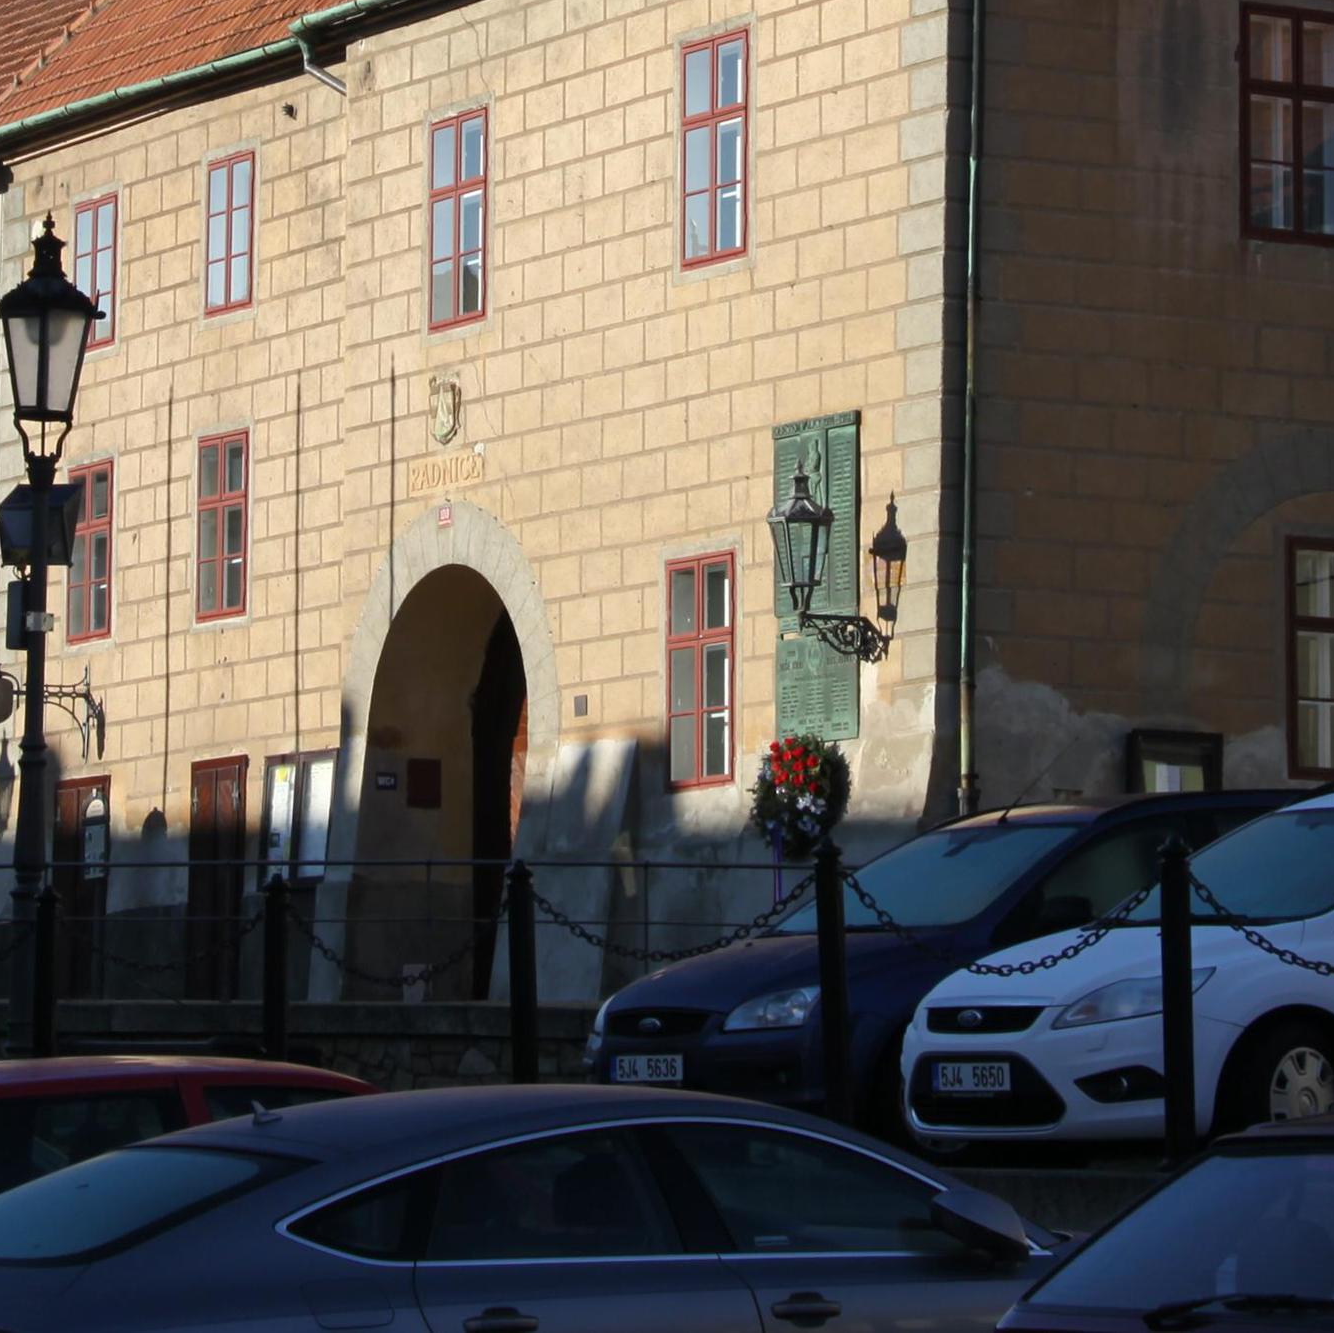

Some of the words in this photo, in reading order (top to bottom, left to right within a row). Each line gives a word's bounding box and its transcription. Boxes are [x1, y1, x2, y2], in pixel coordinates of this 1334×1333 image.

[411, 455, 481, 492] RADNICE
[618, 1058, 638, 1079] 5J4
[646, 1058, 677, 1077] 5636
[941, 1066, 963, 1087] 5J4
[972, 1066, 1004, 1087] 5650
